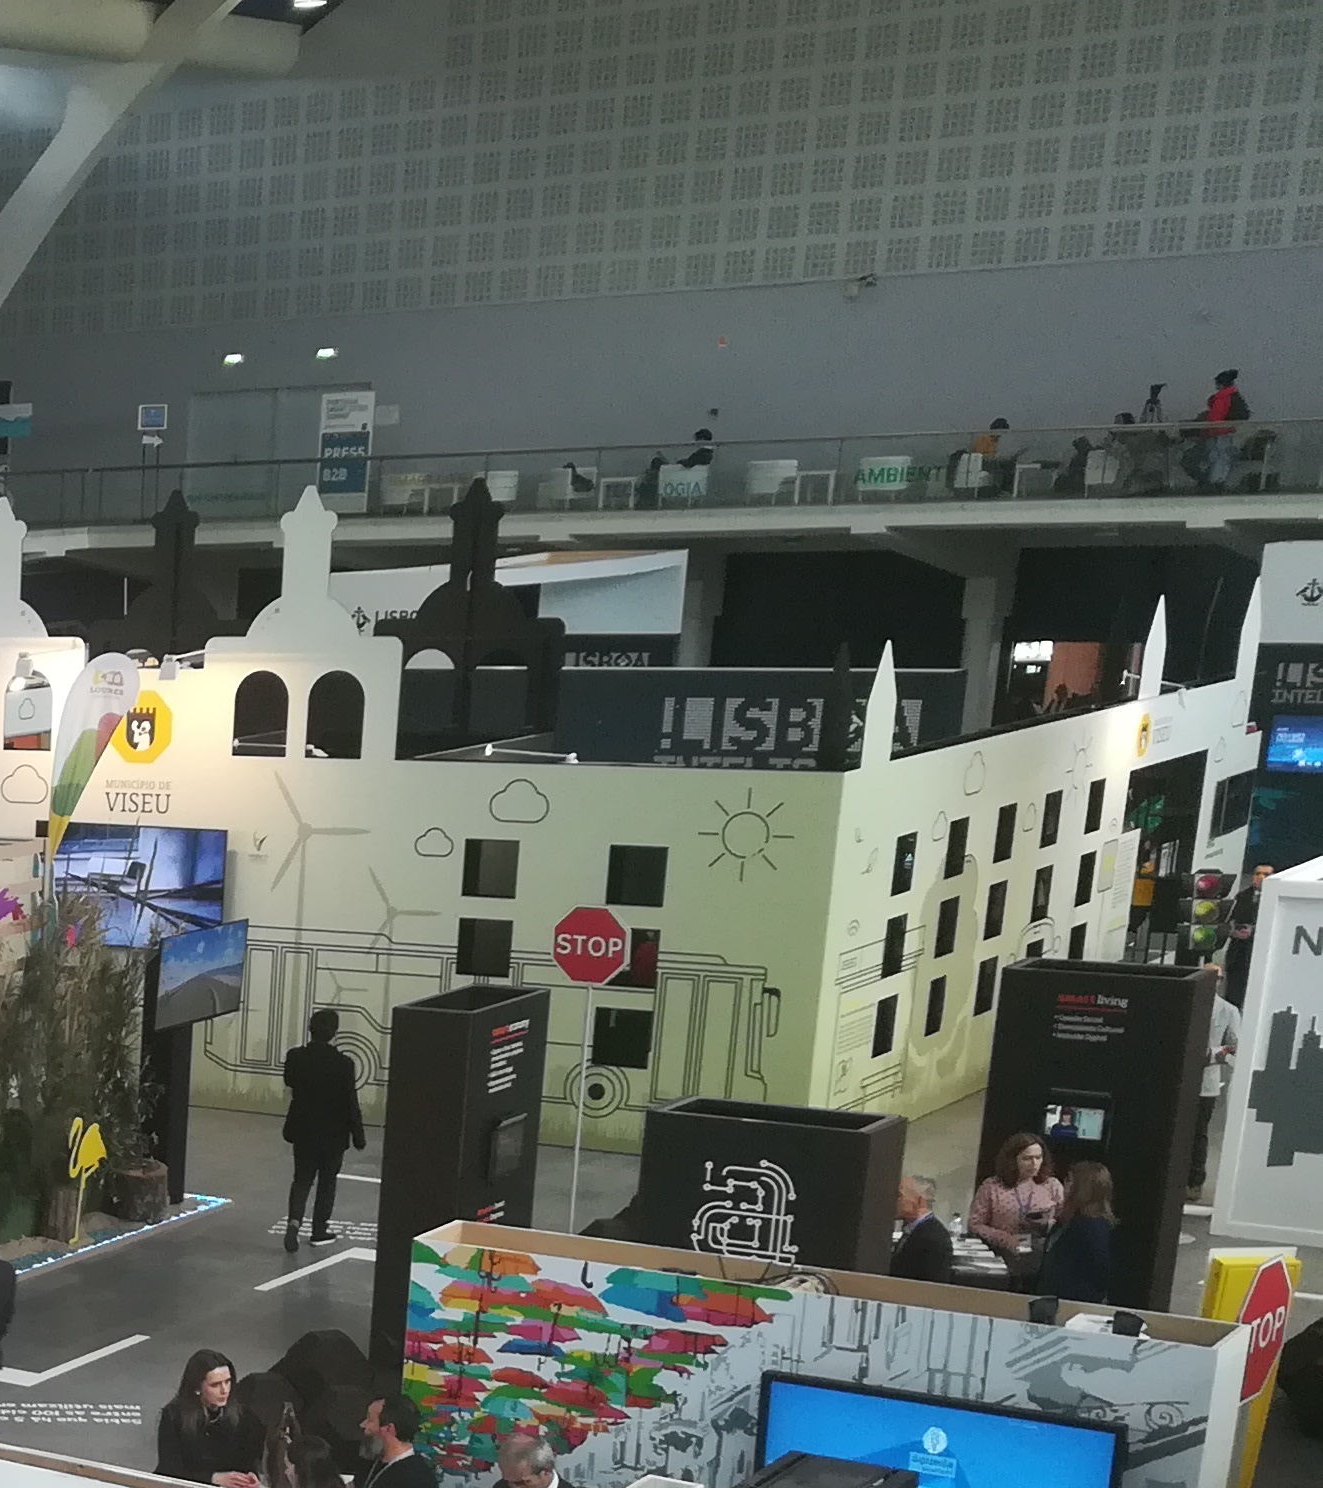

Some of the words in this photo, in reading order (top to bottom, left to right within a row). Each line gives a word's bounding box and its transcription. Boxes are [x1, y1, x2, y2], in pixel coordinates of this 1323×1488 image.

[106, 778, 155, 790] MUNICÍPIO
[158, 780, 172, 790] DE
[105, 792, 171, 814] VISEU
[555, 931, 626, 962] STOP
[1249, 1303, 1287, 1355] TOP
